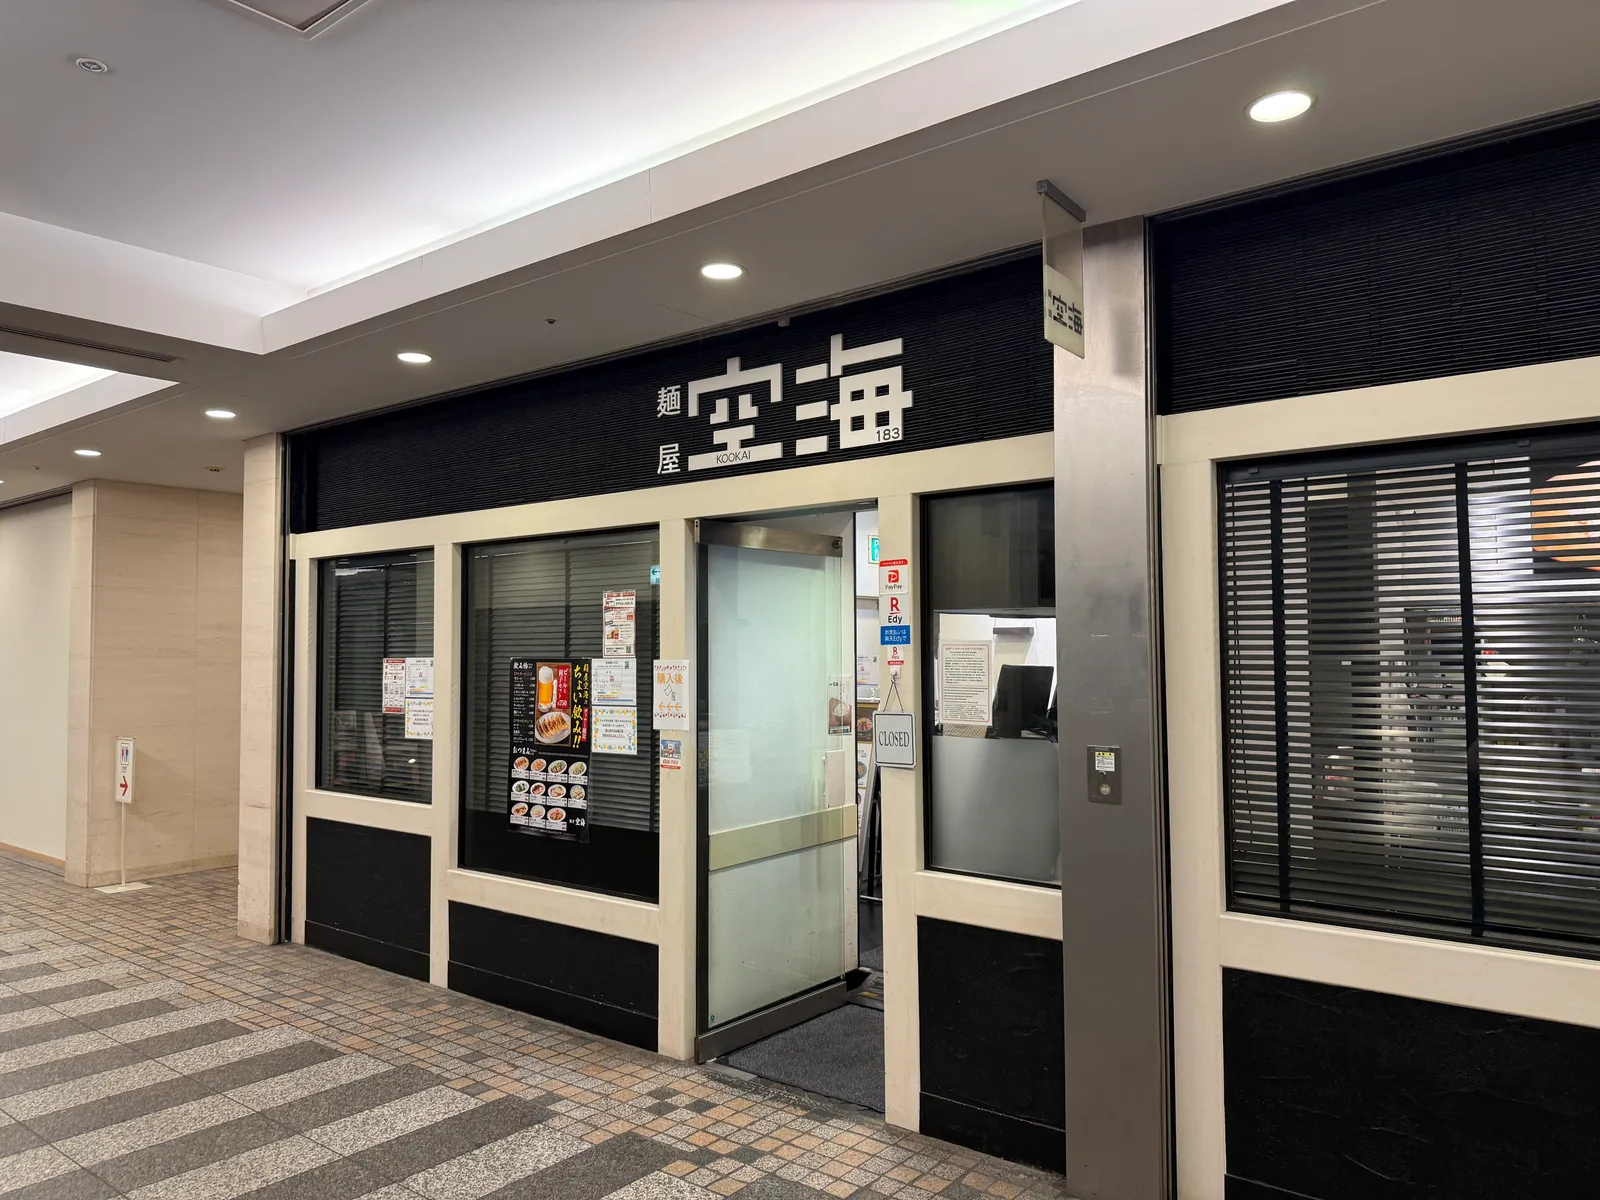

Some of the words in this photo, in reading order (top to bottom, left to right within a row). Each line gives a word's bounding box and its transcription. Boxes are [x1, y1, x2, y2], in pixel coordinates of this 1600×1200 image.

[1052, 294, 1083, 336] 空海
[688, 333, 913, 471] 空海
[657, 384, 681, 475] 麺屋
[876, 427, 900, 442] 183
[890, 597, 900, 612] R
[888, 615, 902, 625] Edy
[656, 672, 683, 685] 購入後
[879, 730, 910, 748] CLOSED
